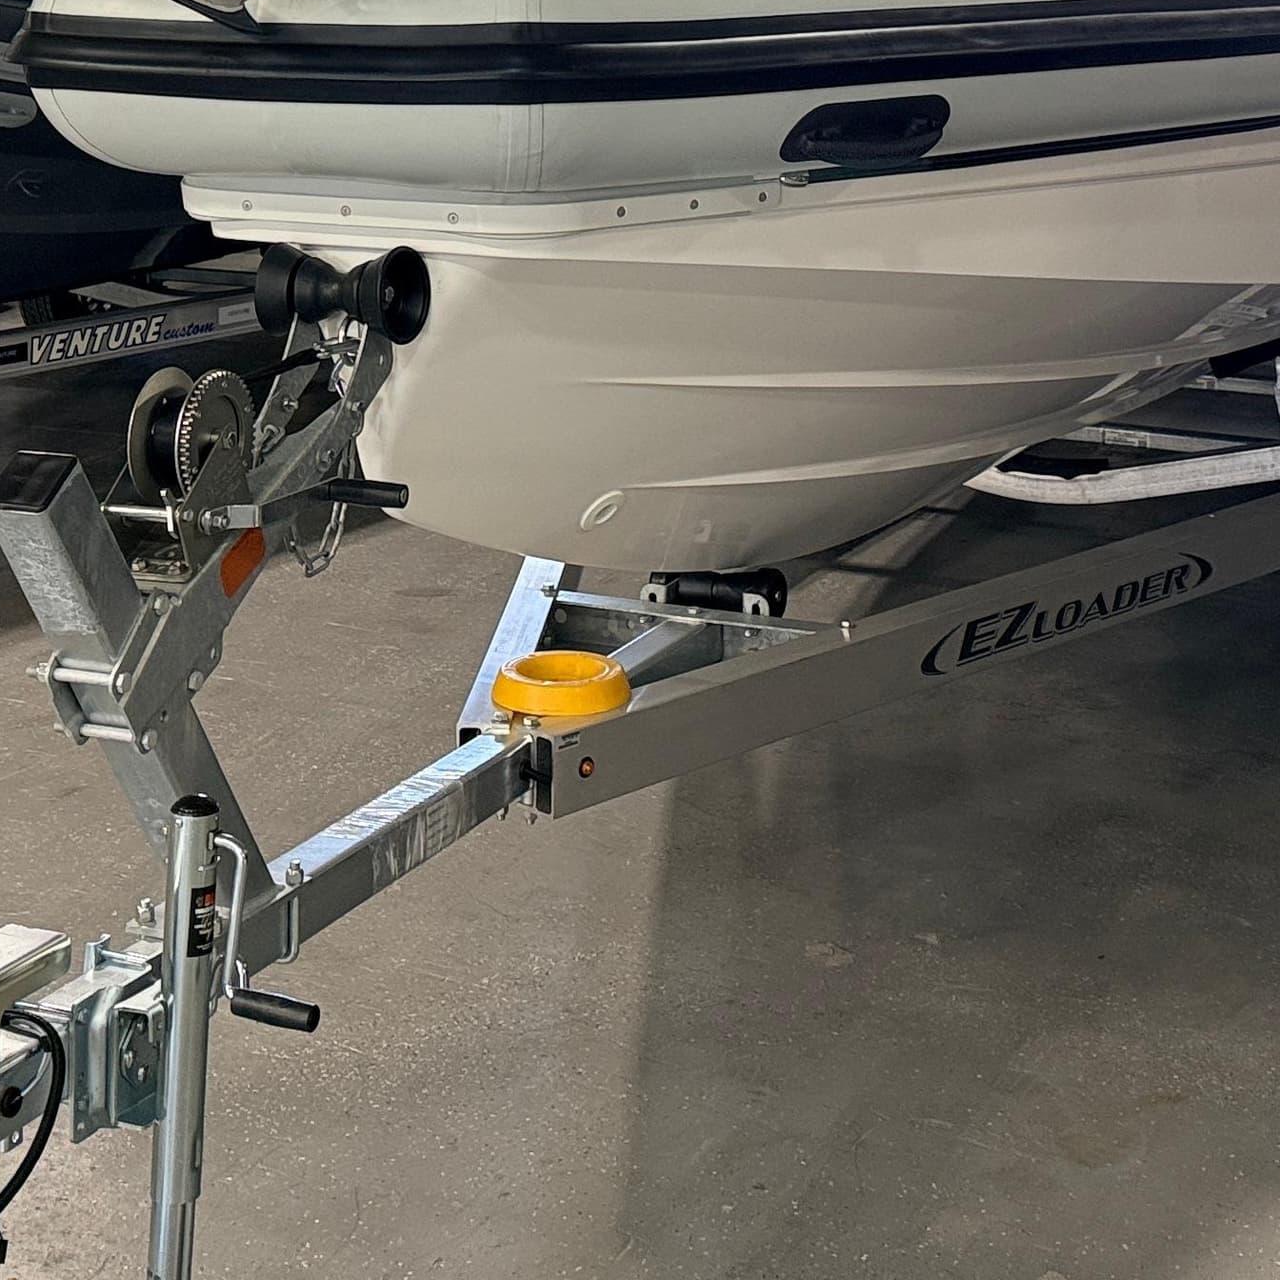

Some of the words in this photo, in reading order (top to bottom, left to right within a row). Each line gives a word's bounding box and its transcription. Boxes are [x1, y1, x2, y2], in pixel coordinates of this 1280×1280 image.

[30, 313, 167, 365] VENTURE
[163, 322, 215, 340] custom
[956, 563, 1191, 667] EZLOADER
